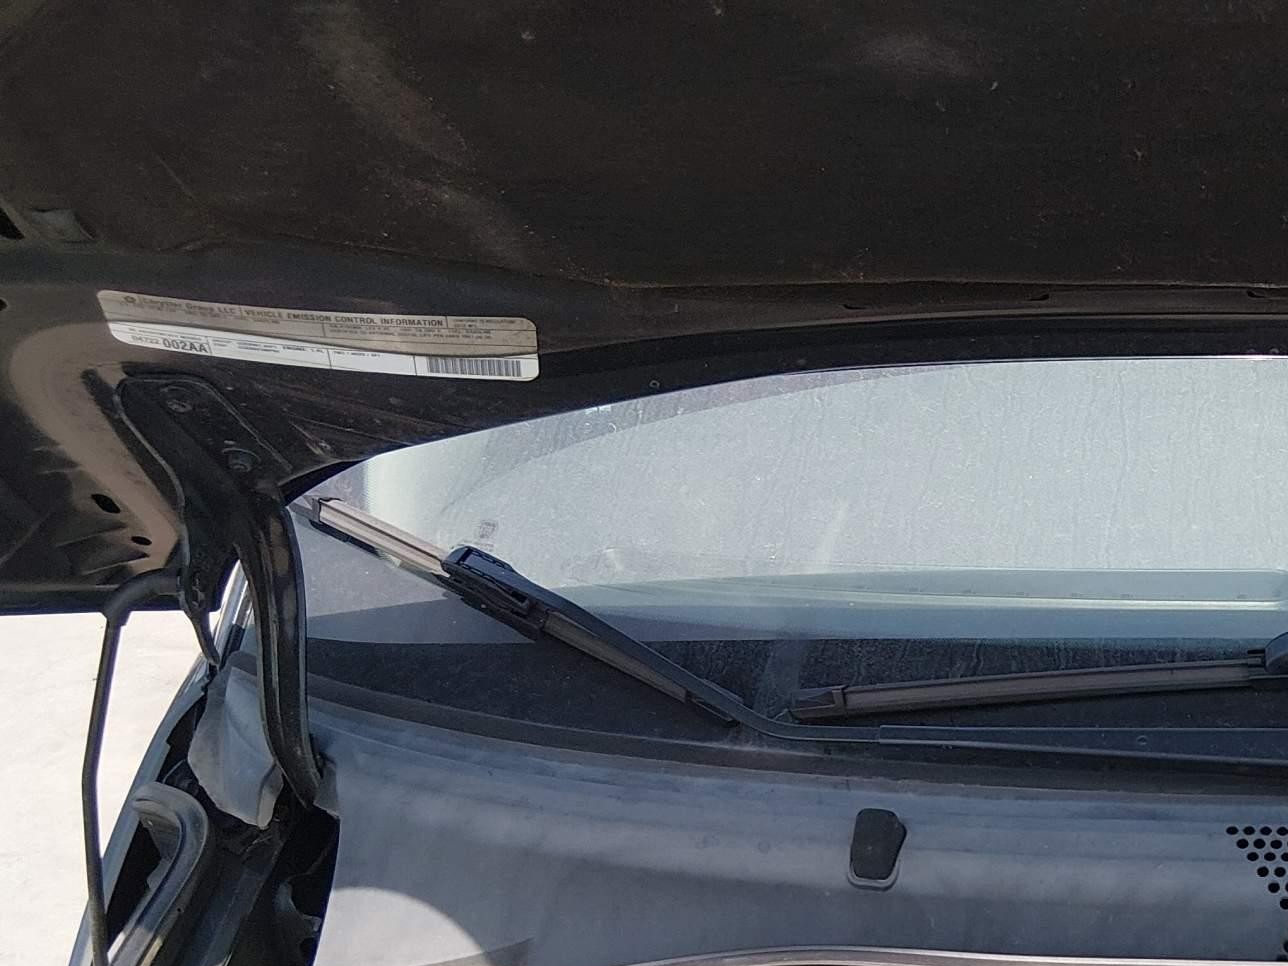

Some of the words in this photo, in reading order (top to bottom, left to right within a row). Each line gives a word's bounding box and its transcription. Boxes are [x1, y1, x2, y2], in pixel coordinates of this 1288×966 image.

[244, 309, 283, 319] VEHICLE
[287, 312, 332, 322] EMISSION
[335, 316, 377, 325] CONTROL
[380, 318, 443, 327] INFORMATION
[162, 338, 208, 354] 002AA
